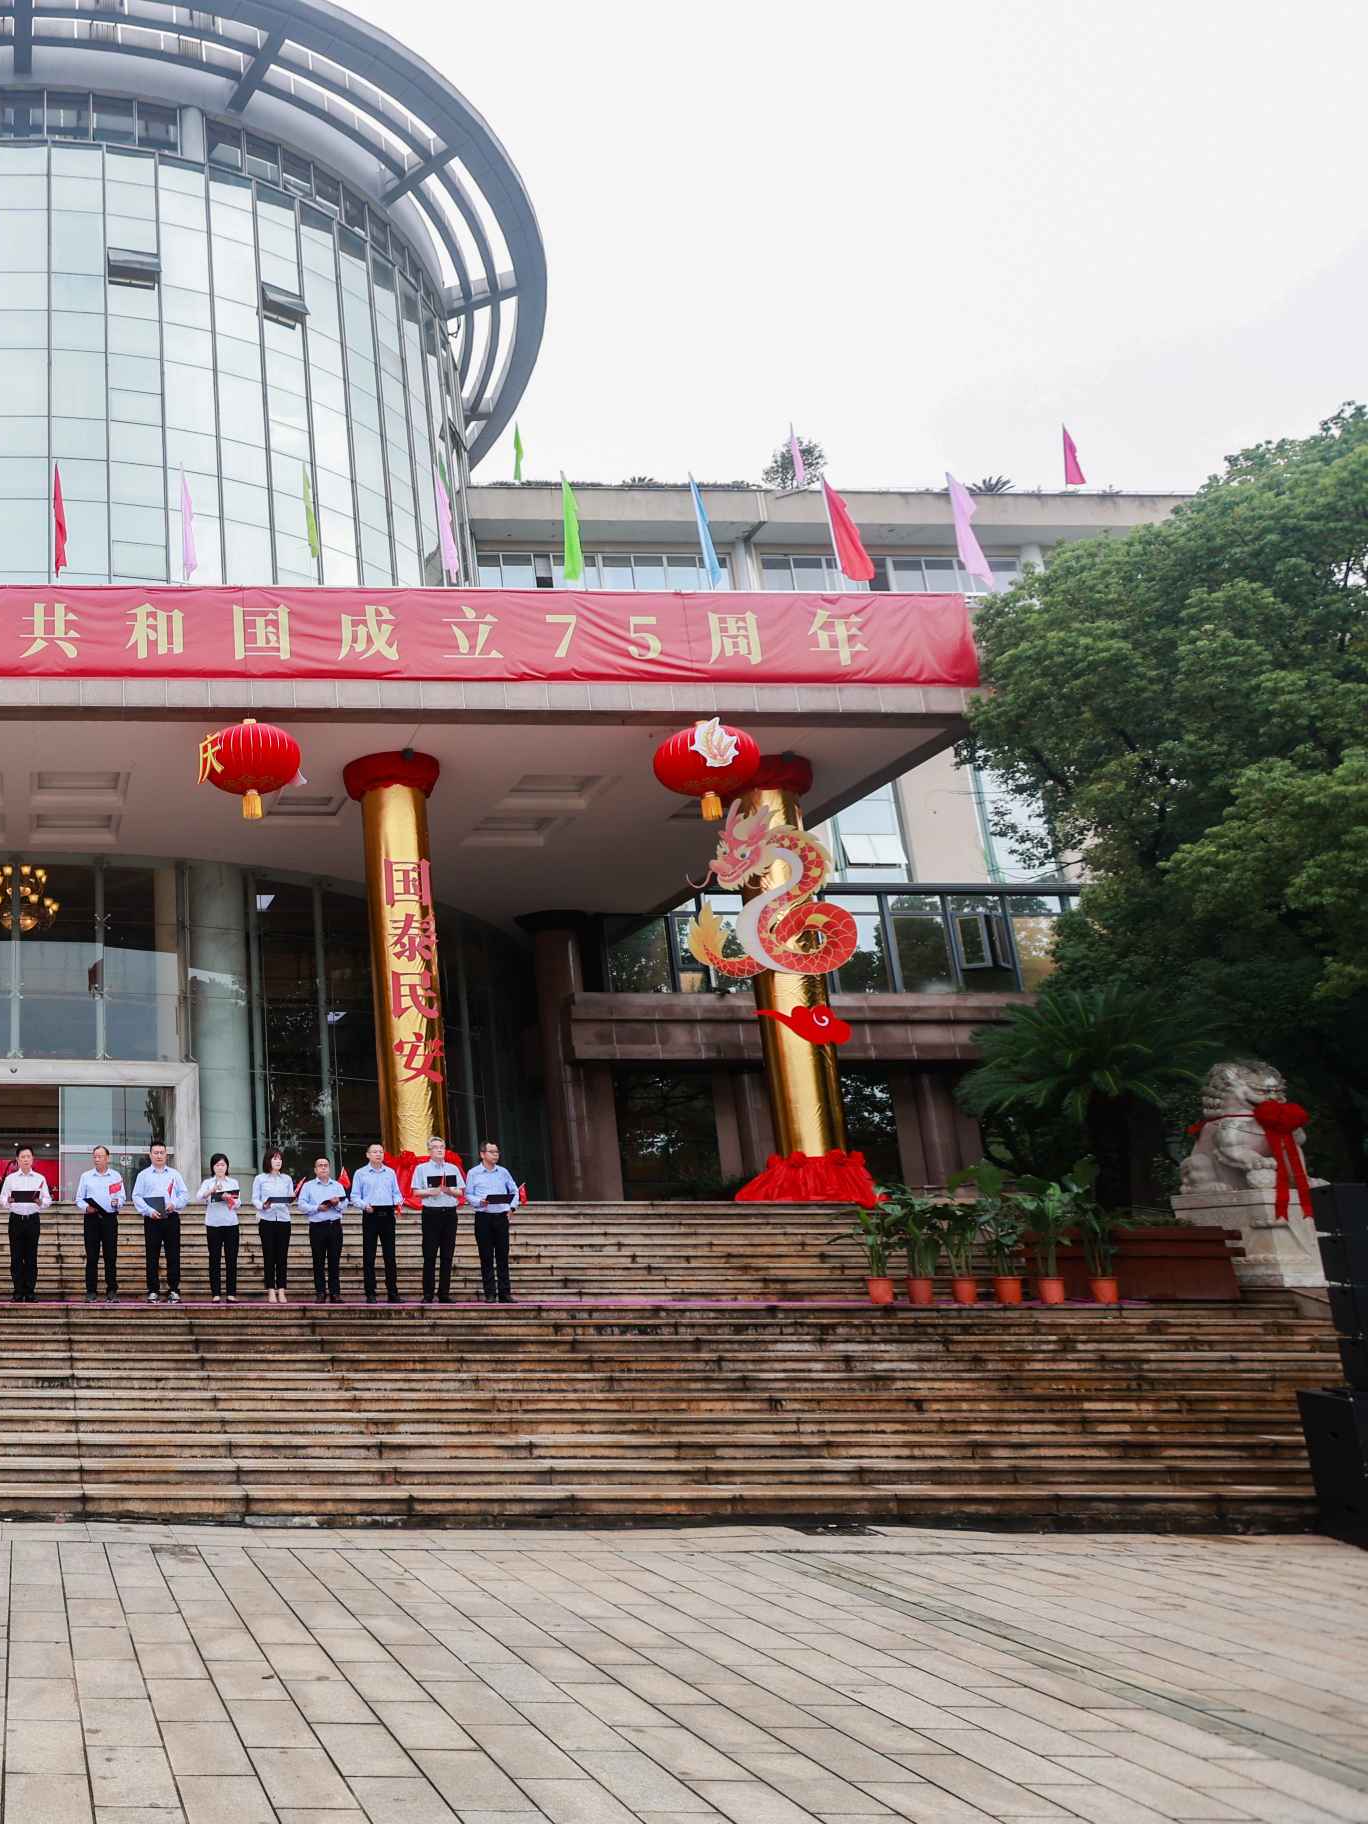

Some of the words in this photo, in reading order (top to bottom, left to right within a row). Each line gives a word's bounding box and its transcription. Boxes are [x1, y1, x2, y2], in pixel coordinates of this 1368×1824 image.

[197, 731, 224, 784] 庆
[384, 858, 444, 1083] 国泰民安
